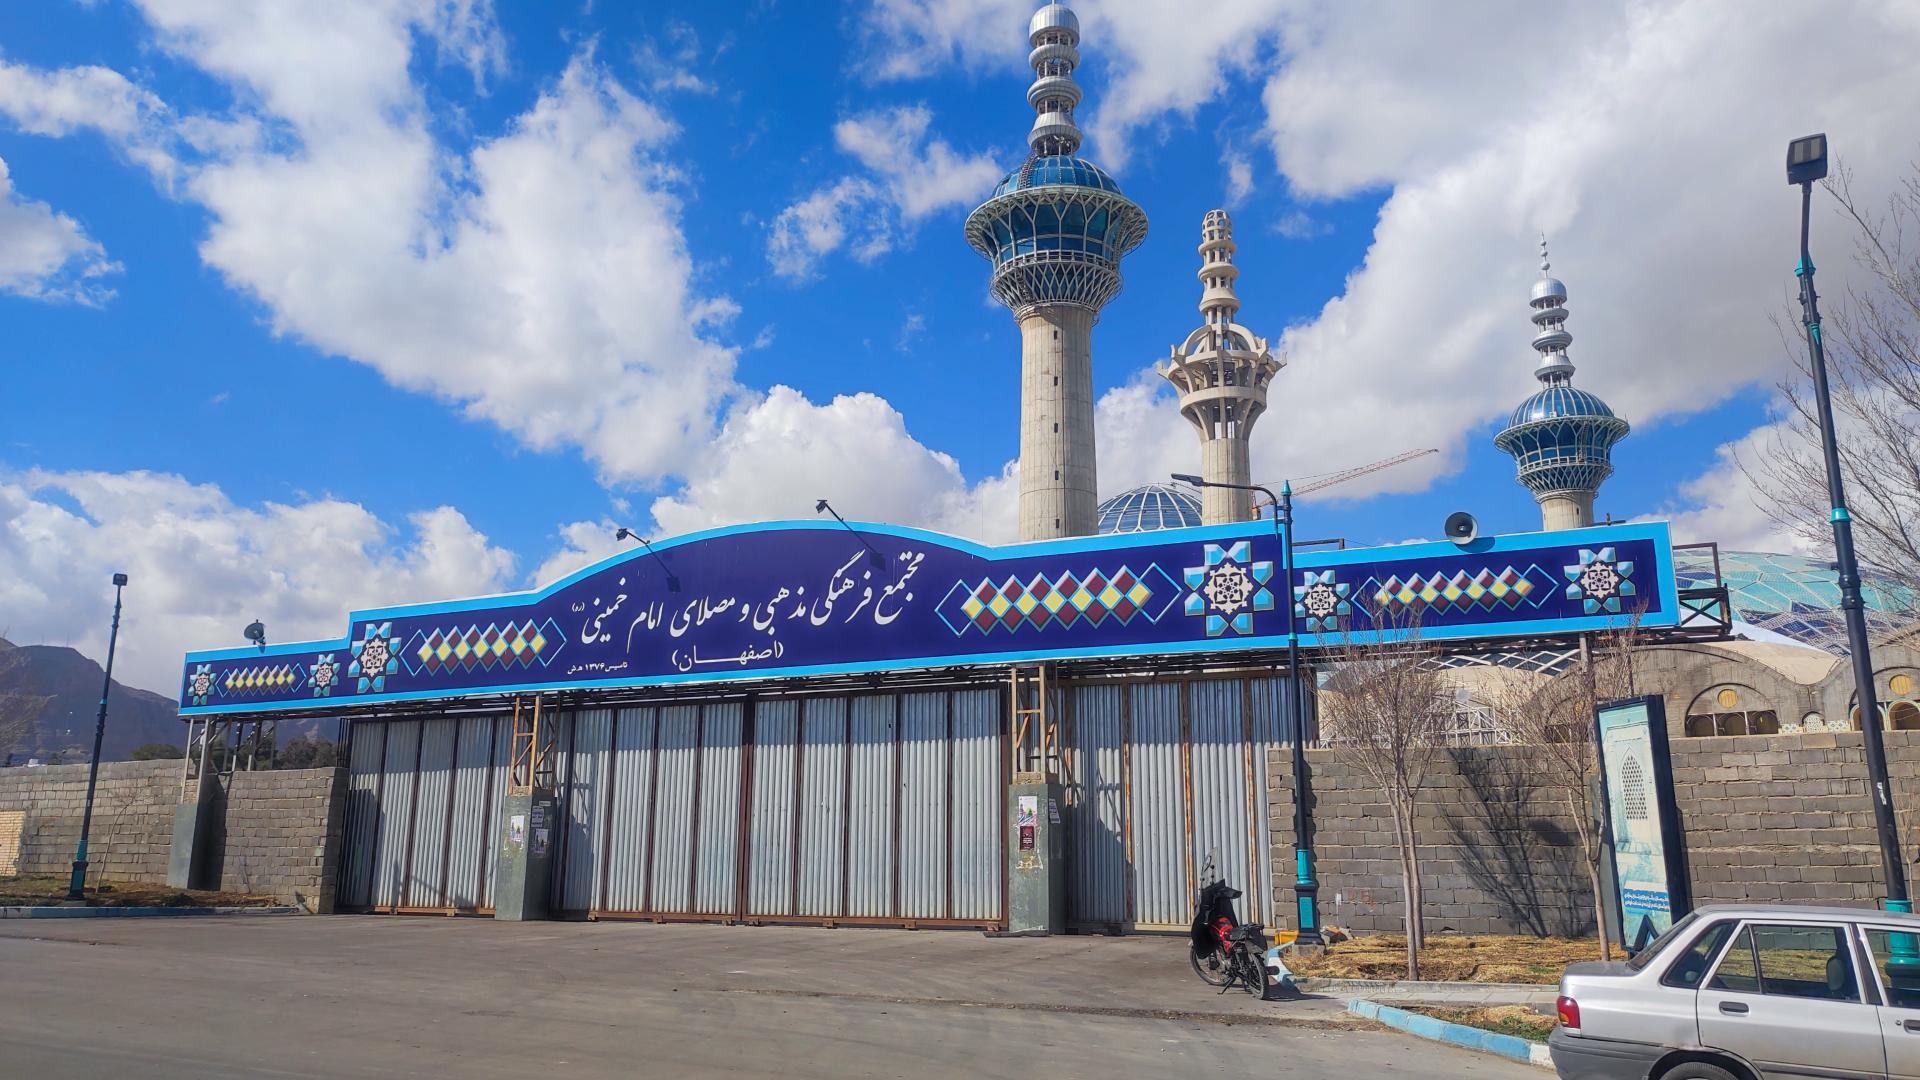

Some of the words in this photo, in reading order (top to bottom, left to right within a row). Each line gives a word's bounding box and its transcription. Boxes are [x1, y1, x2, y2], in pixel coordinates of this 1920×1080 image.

[581, 577, 628, 644] خمینی
[737, 602, 750, 623] و
[753, 585, 807, 635] مذهبی
[810, 548, 873, 626] فرهنگی
[874, 551, 926, 625] مجتمع
[626, 600, 664, 654] امام
[669, 595, 736, 638] مصلای
